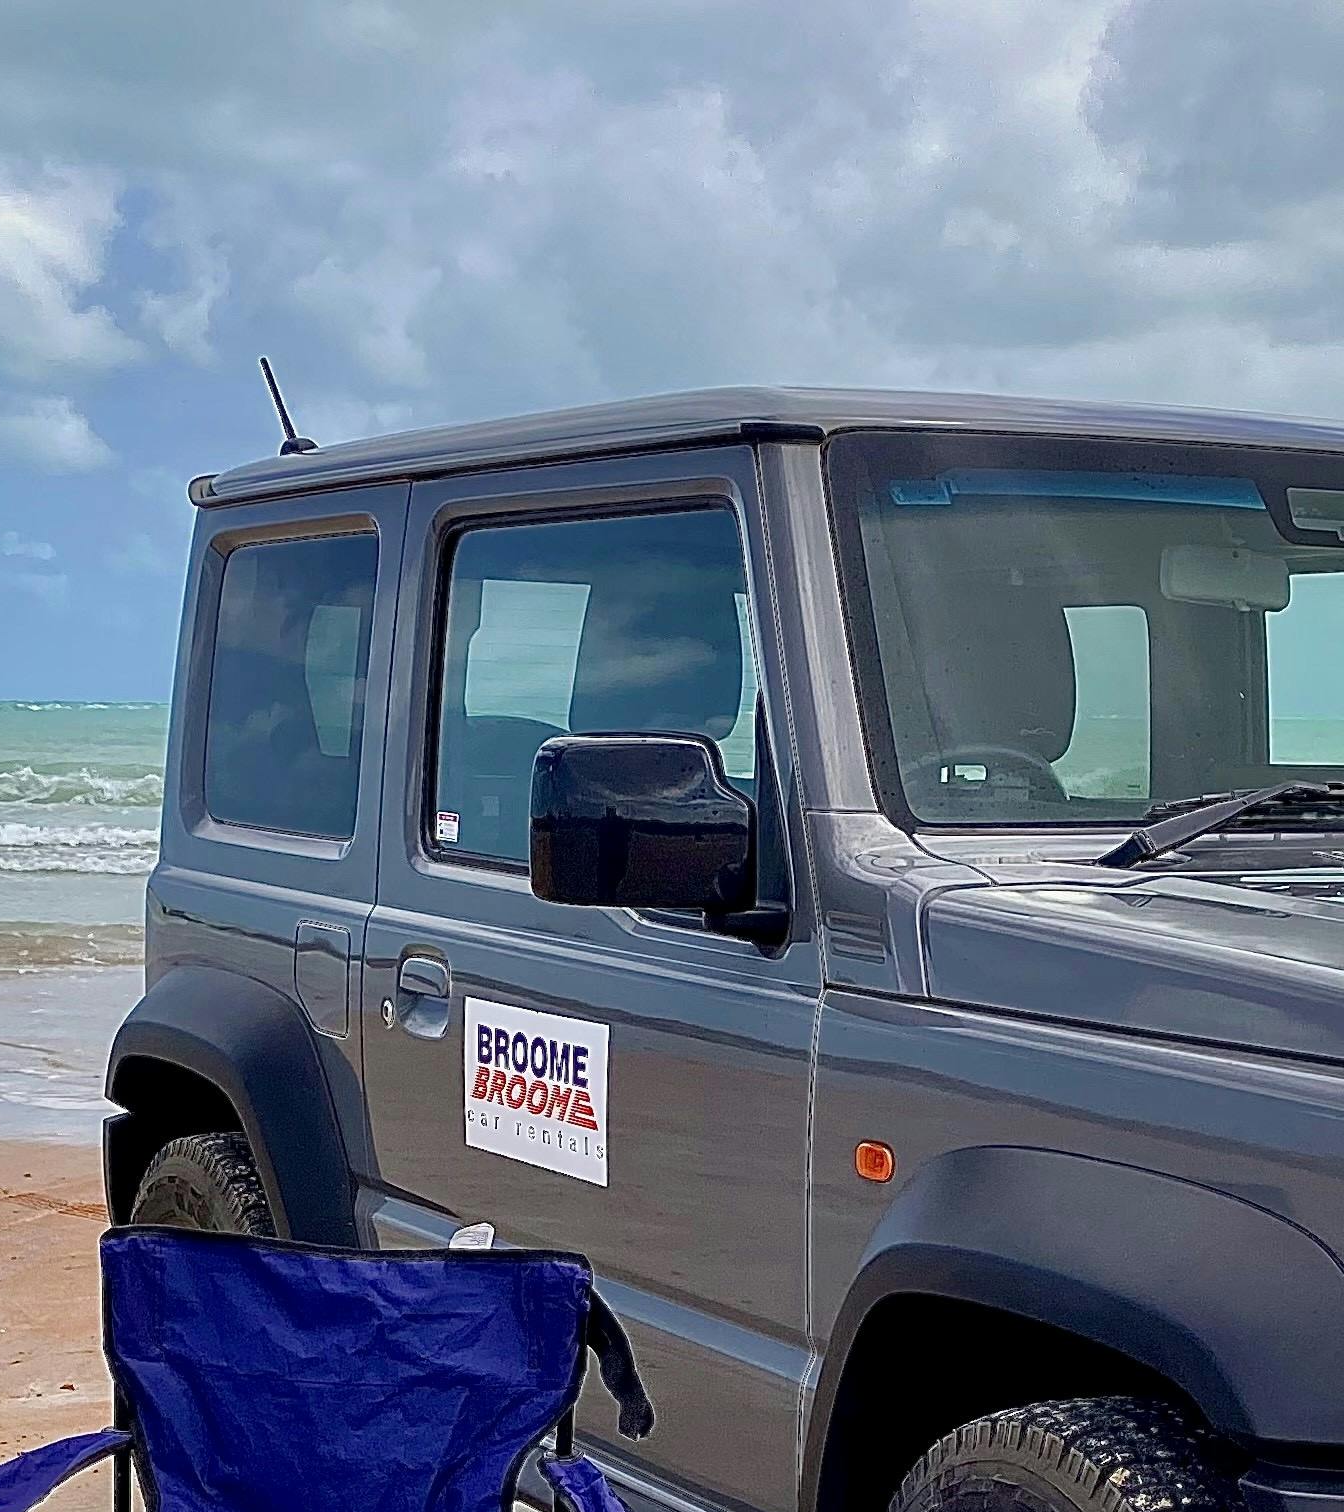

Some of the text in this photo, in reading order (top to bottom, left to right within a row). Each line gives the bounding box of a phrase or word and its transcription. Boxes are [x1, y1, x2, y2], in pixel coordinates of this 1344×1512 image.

[477, 1023, 589, 1089] BROOME
[469, 1065, 599, 1131] BROOME
[467, 1108, 604, 1160] car rentals
